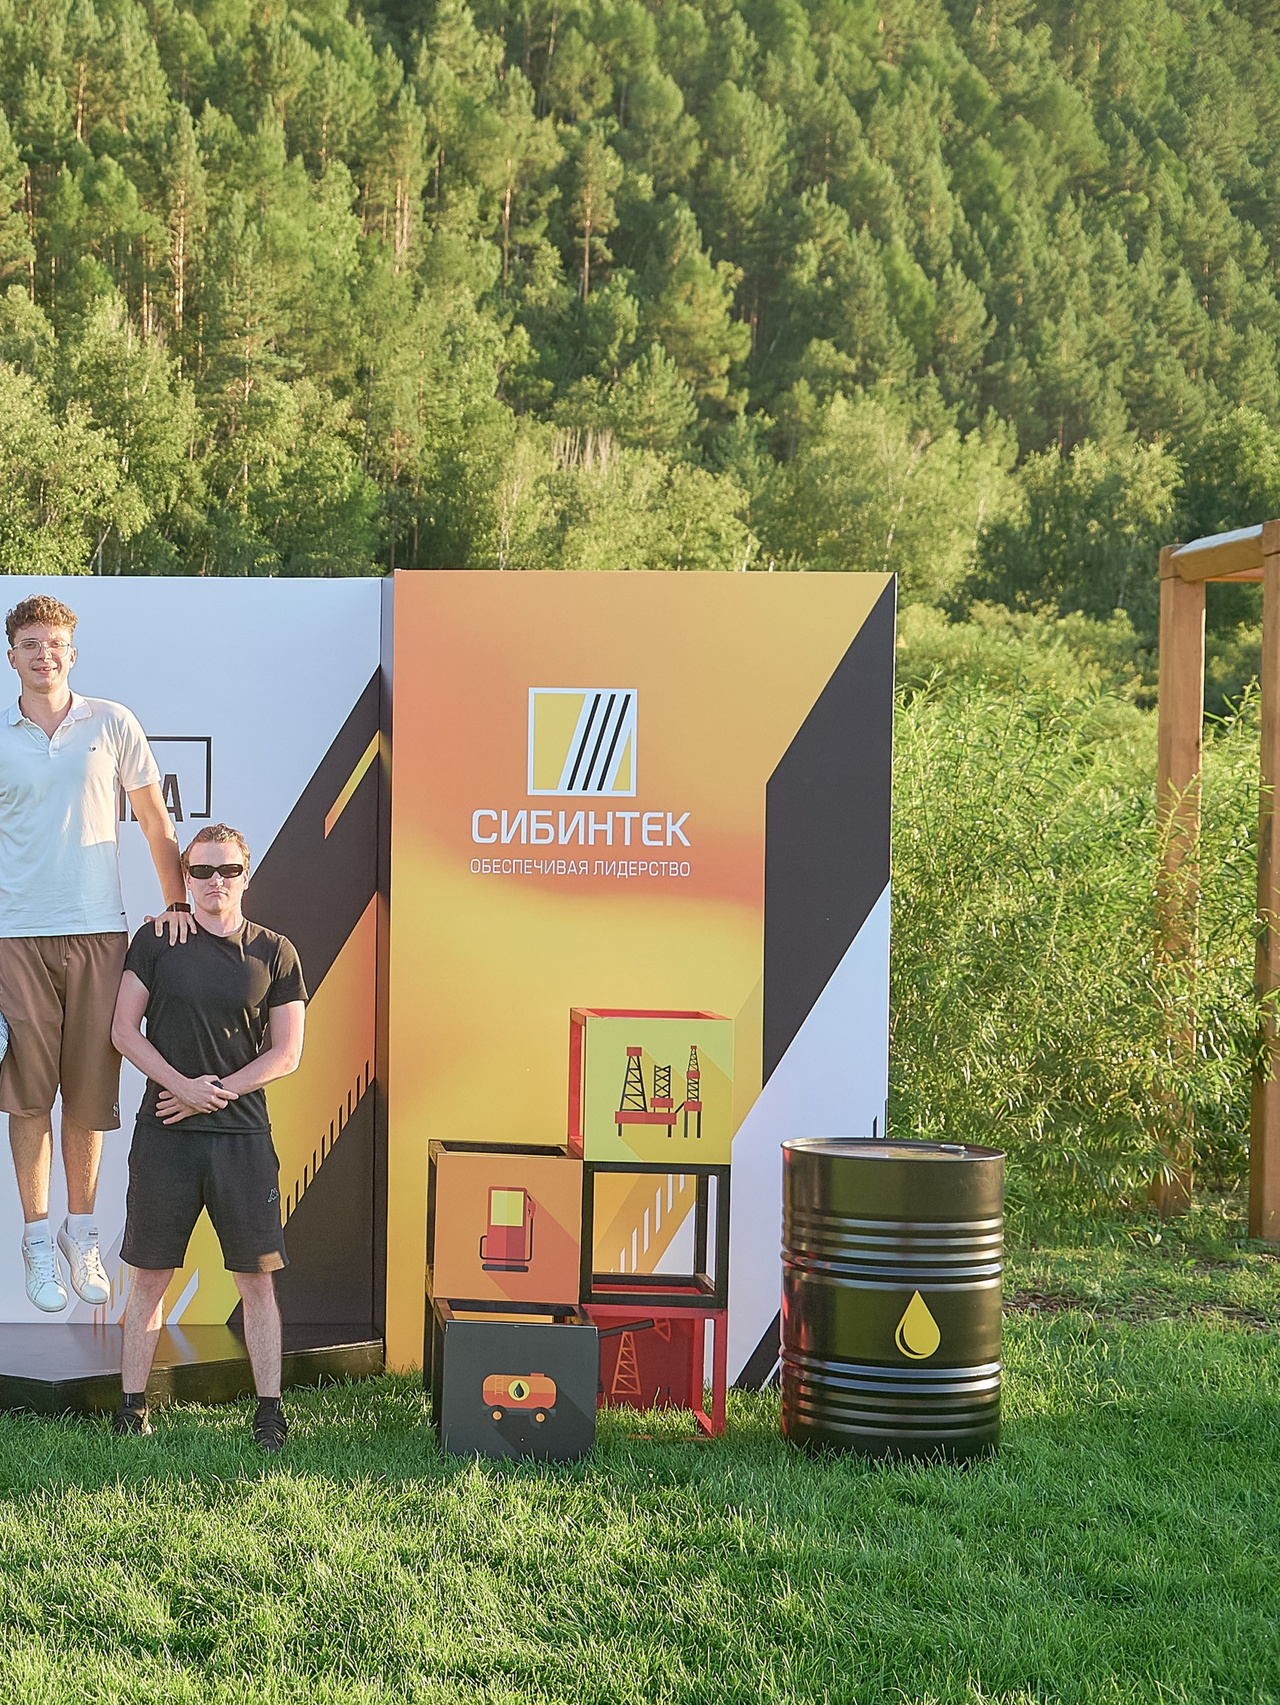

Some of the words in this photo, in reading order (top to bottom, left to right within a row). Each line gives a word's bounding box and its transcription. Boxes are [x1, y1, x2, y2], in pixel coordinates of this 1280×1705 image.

[471, 809, 691, 846] СИБИНТЕК
[470, 858, 588, 875] ОБЕСПЕЧИВАЯ
[593, 860, 691, 878] ЛИДЕРСТВО
